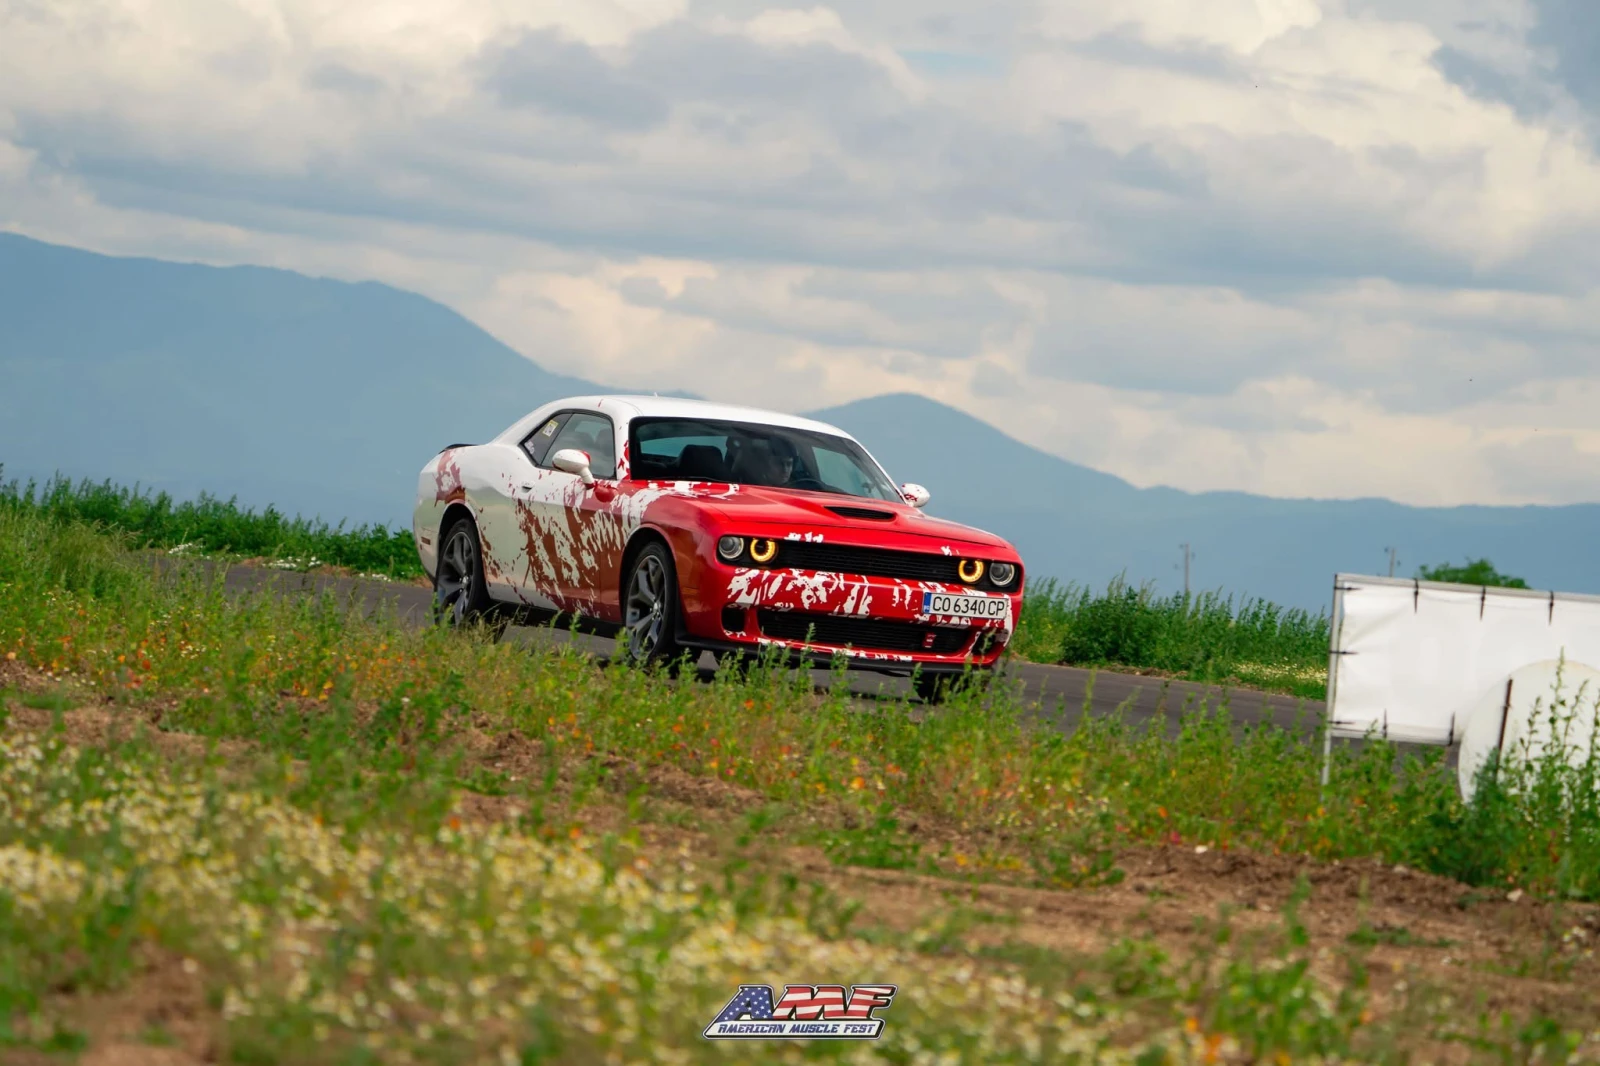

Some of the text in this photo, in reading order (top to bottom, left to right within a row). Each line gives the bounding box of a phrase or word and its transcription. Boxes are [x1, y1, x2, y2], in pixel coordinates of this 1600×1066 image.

[933, 596, 1005, 617] CO 6340 CP
